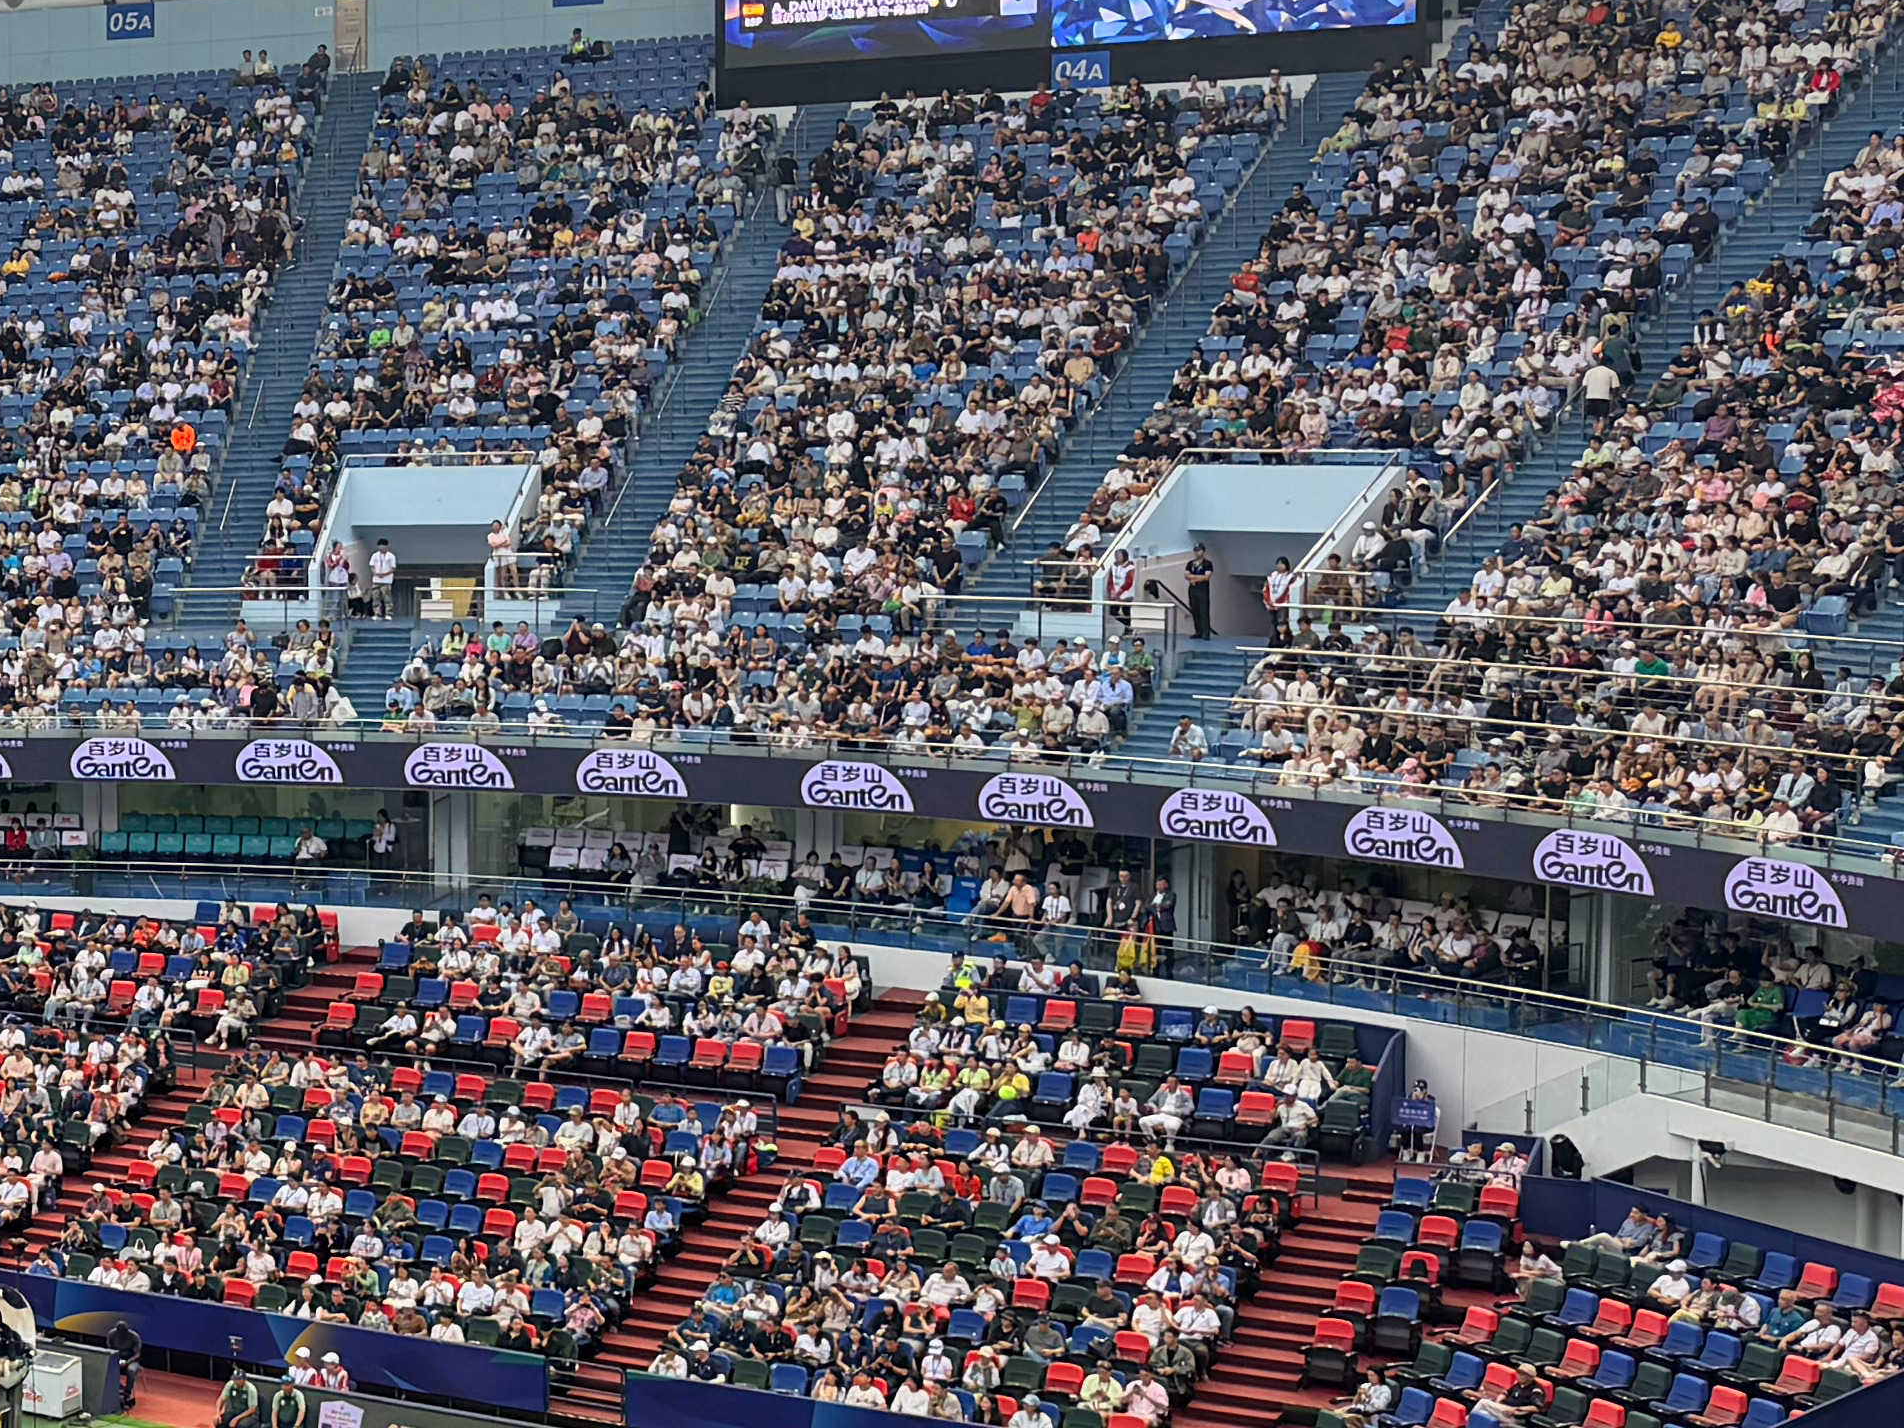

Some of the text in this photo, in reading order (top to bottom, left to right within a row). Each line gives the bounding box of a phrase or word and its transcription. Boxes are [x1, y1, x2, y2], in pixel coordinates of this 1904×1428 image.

[110, 12, 152, 31] 05A
[1055, 59, 1103, 82] 04A
[89, 741, 145, 756] 百岁山
[254, 743, 312, 758] 百岁山
[424, 747, 482, 762] 百岁山
[597, 753, 656, 769] 百岁山
[821, 765, 882, 783] 百岁山
[999, 777, 1061, 797] 百岁山
[1181, 792, 1244, 814] 百岁山
[1367, 811, 1431, 834] 百岁山
[1556, 833, 1621, 859] 百岁山
[1747, 861, 1814, 889] 百岁山
